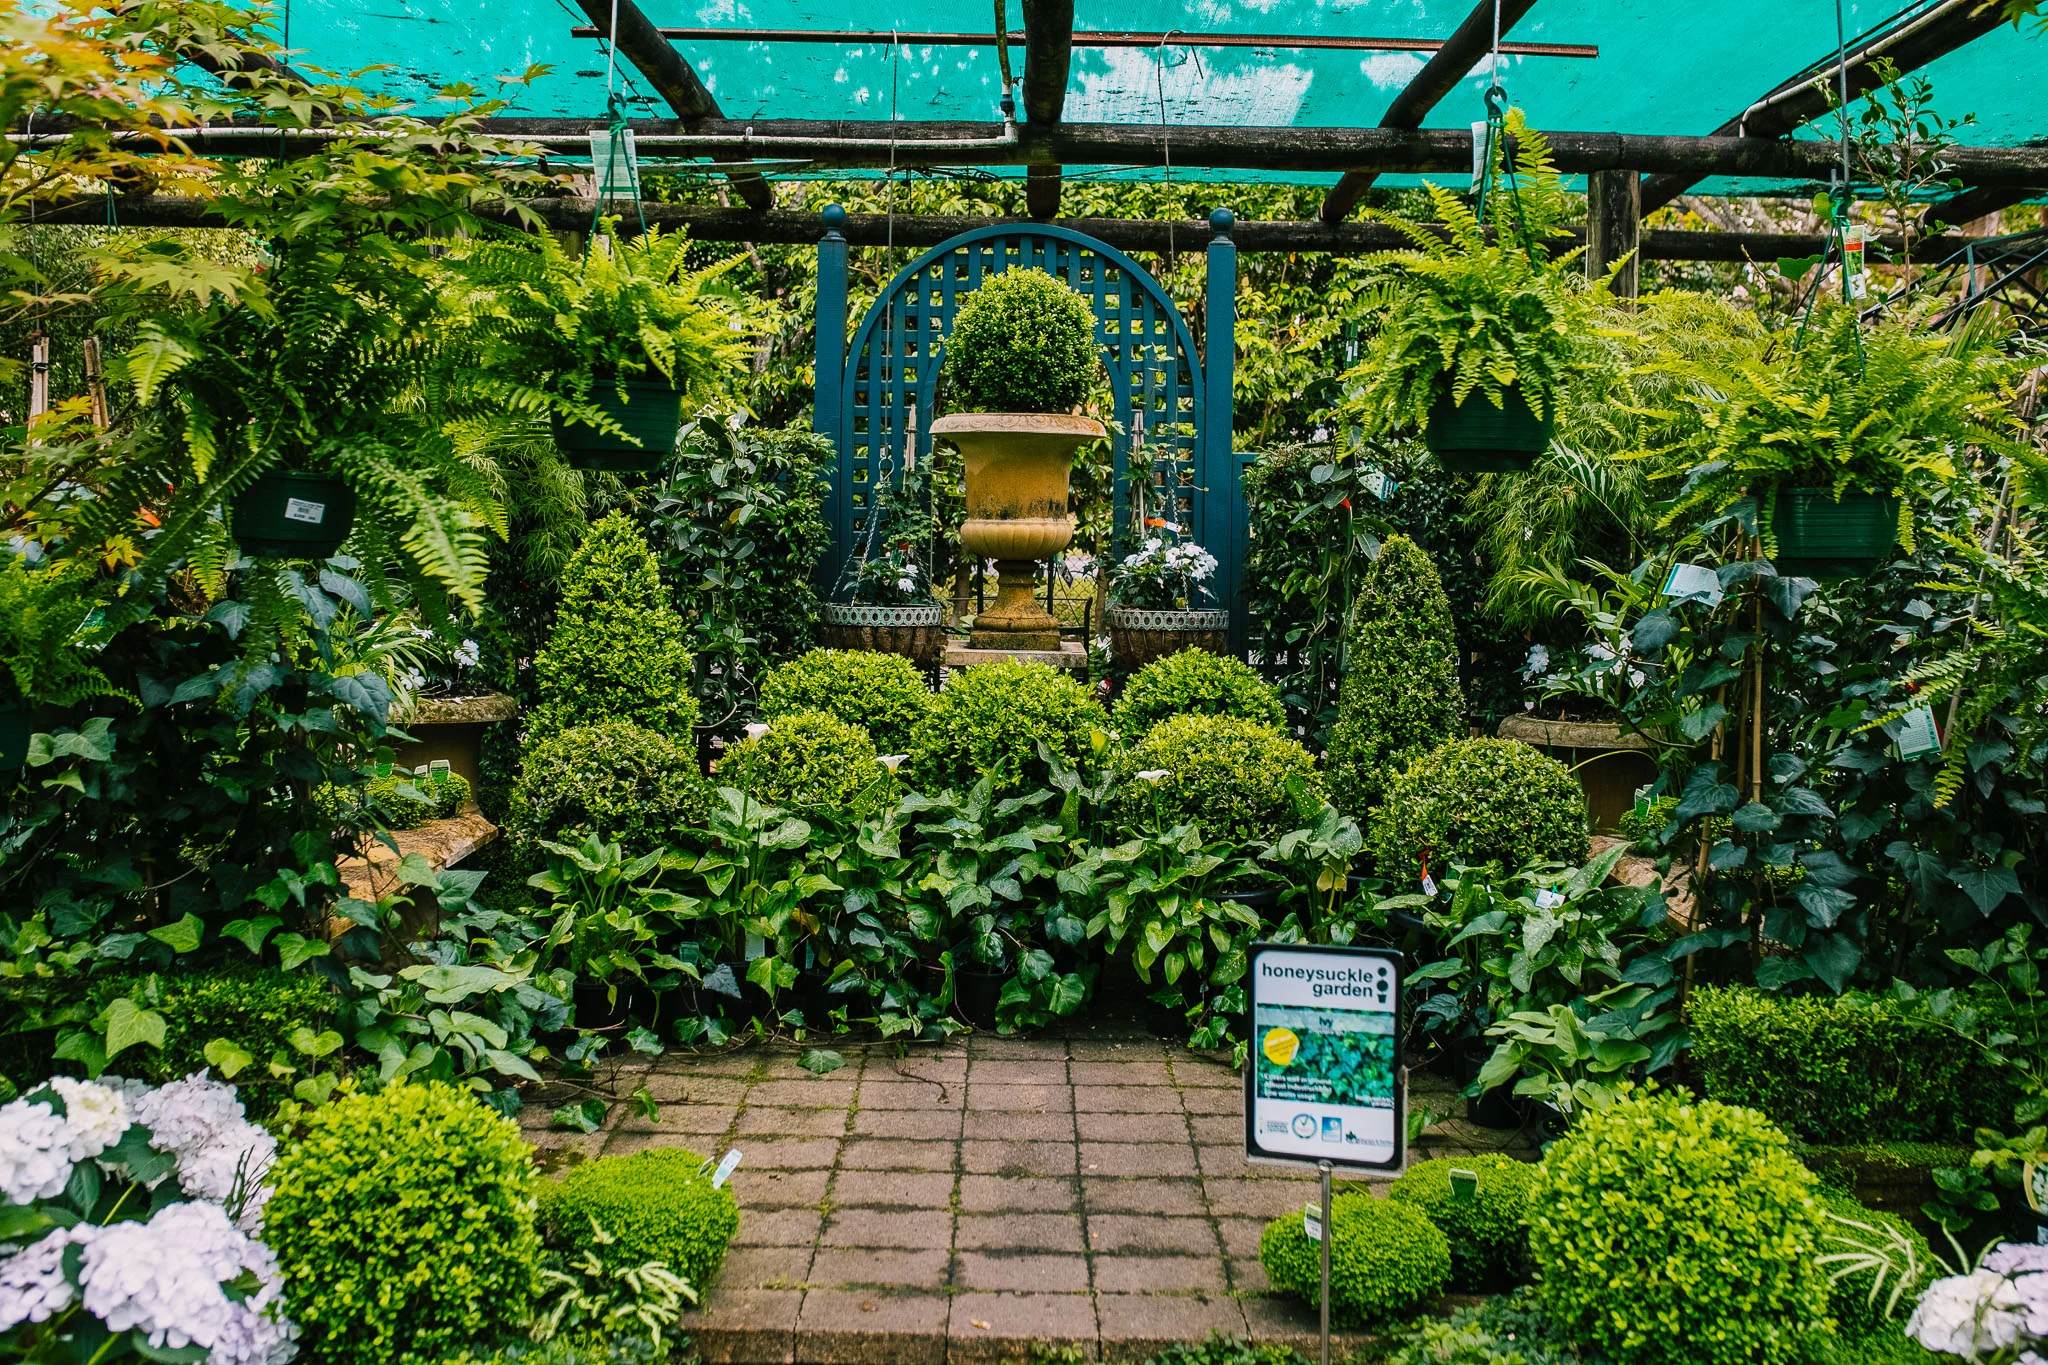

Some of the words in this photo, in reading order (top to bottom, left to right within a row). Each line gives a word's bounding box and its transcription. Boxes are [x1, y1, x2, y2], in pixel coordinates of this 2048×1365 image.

[1262, 962, 1373, 983] honeysuckle
[1313, 982, 1373, 998] garden
[1319, 1015, 1333, 1028] Ivy
